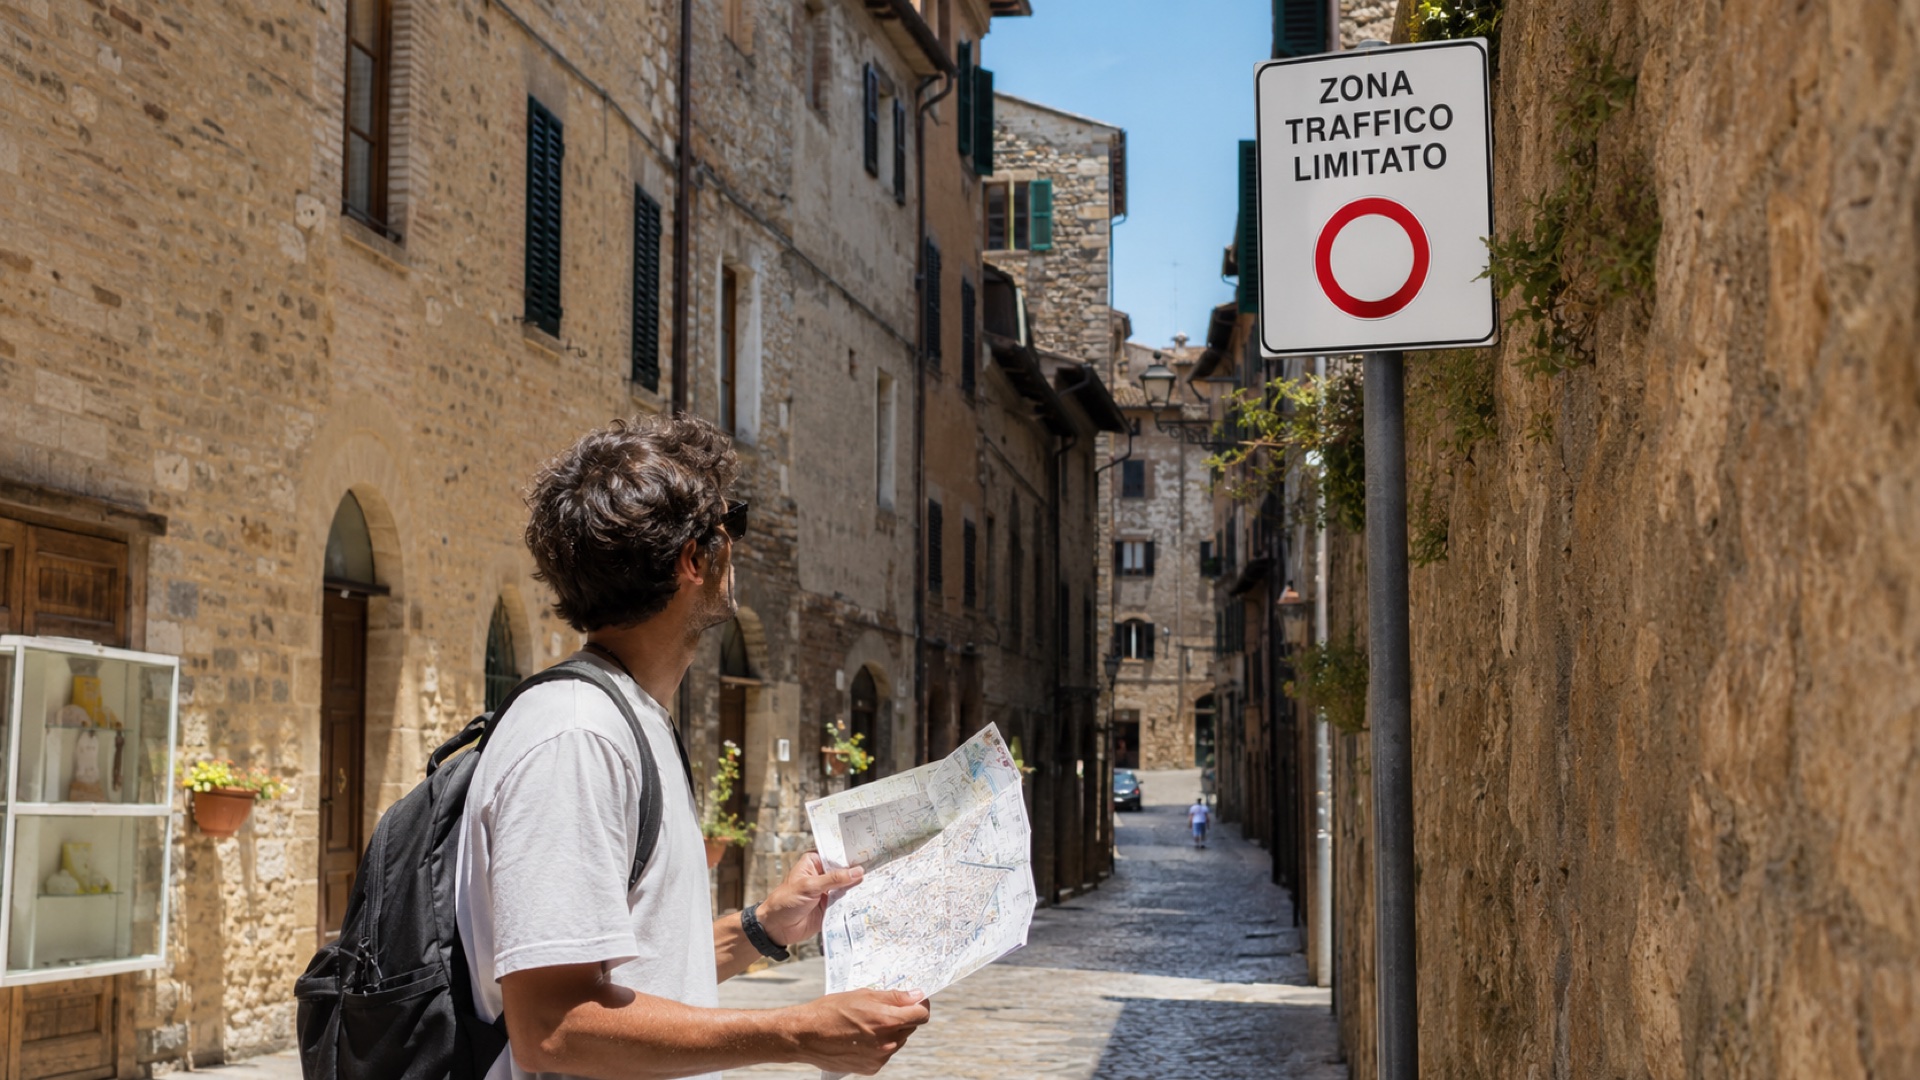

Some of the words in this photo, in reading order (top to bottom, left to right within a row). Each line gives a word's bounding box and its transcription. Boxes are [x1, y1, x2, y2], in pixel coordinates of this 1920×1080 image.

[1319, 70, 1414, 104] ZONA
[1285, 103, 1454, 144] TRAFFICO
[1294, 142, 1447, 181] LIMITATO
